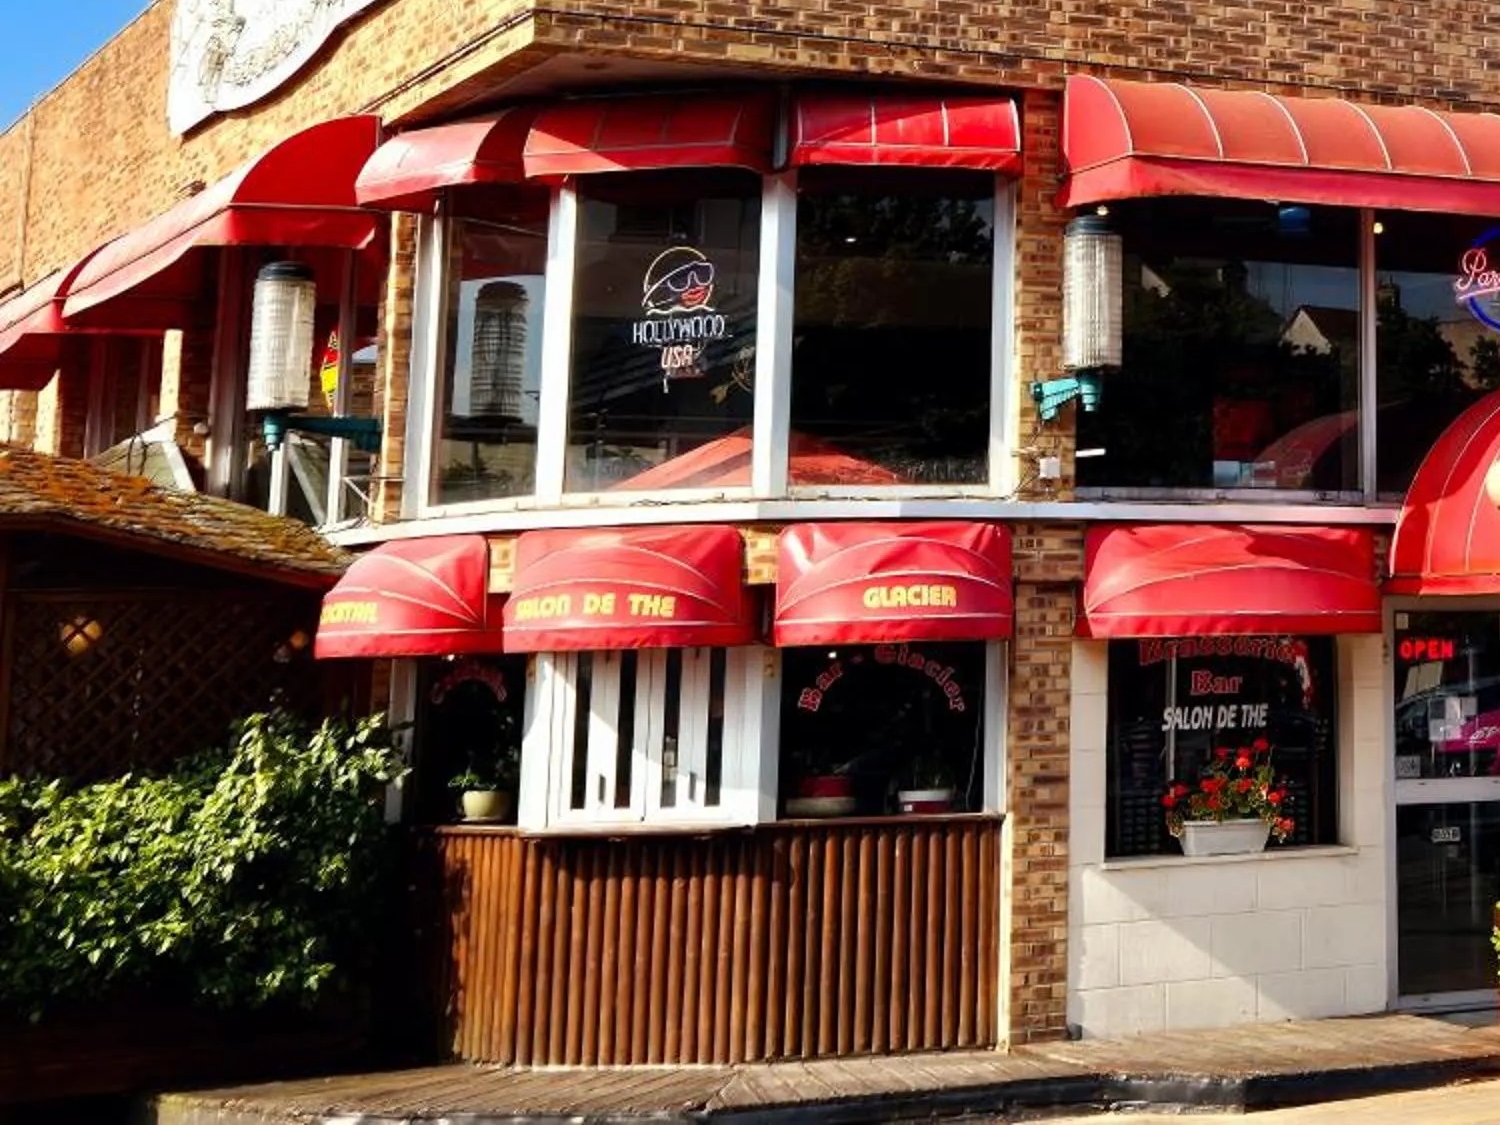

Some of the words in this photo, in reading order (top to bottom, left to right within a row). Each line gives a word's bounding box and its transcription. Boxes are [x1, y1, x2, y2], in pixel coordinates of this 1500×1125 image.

[633, 315, 725, 344] HOLLYWOOD
[661, 345, 694, 368] USA
[515, 595, 570, 620] SALON
[583, 594, 615, 615] DE
[629, 594, 675, 617] THE
[863, 585, 957, 608] GLACIER
[1399, 639, 1455, 660] OPEN
[797, 662, 844, 712] Bar
[874, 643, 966, 712] Glacier
[1189, 670, 1244, 696] Bar
[1162, 706, 1213, 732] SALON
[1217, 706, 1237, 729] DE
[1241, 703, 1269, 728] THE
